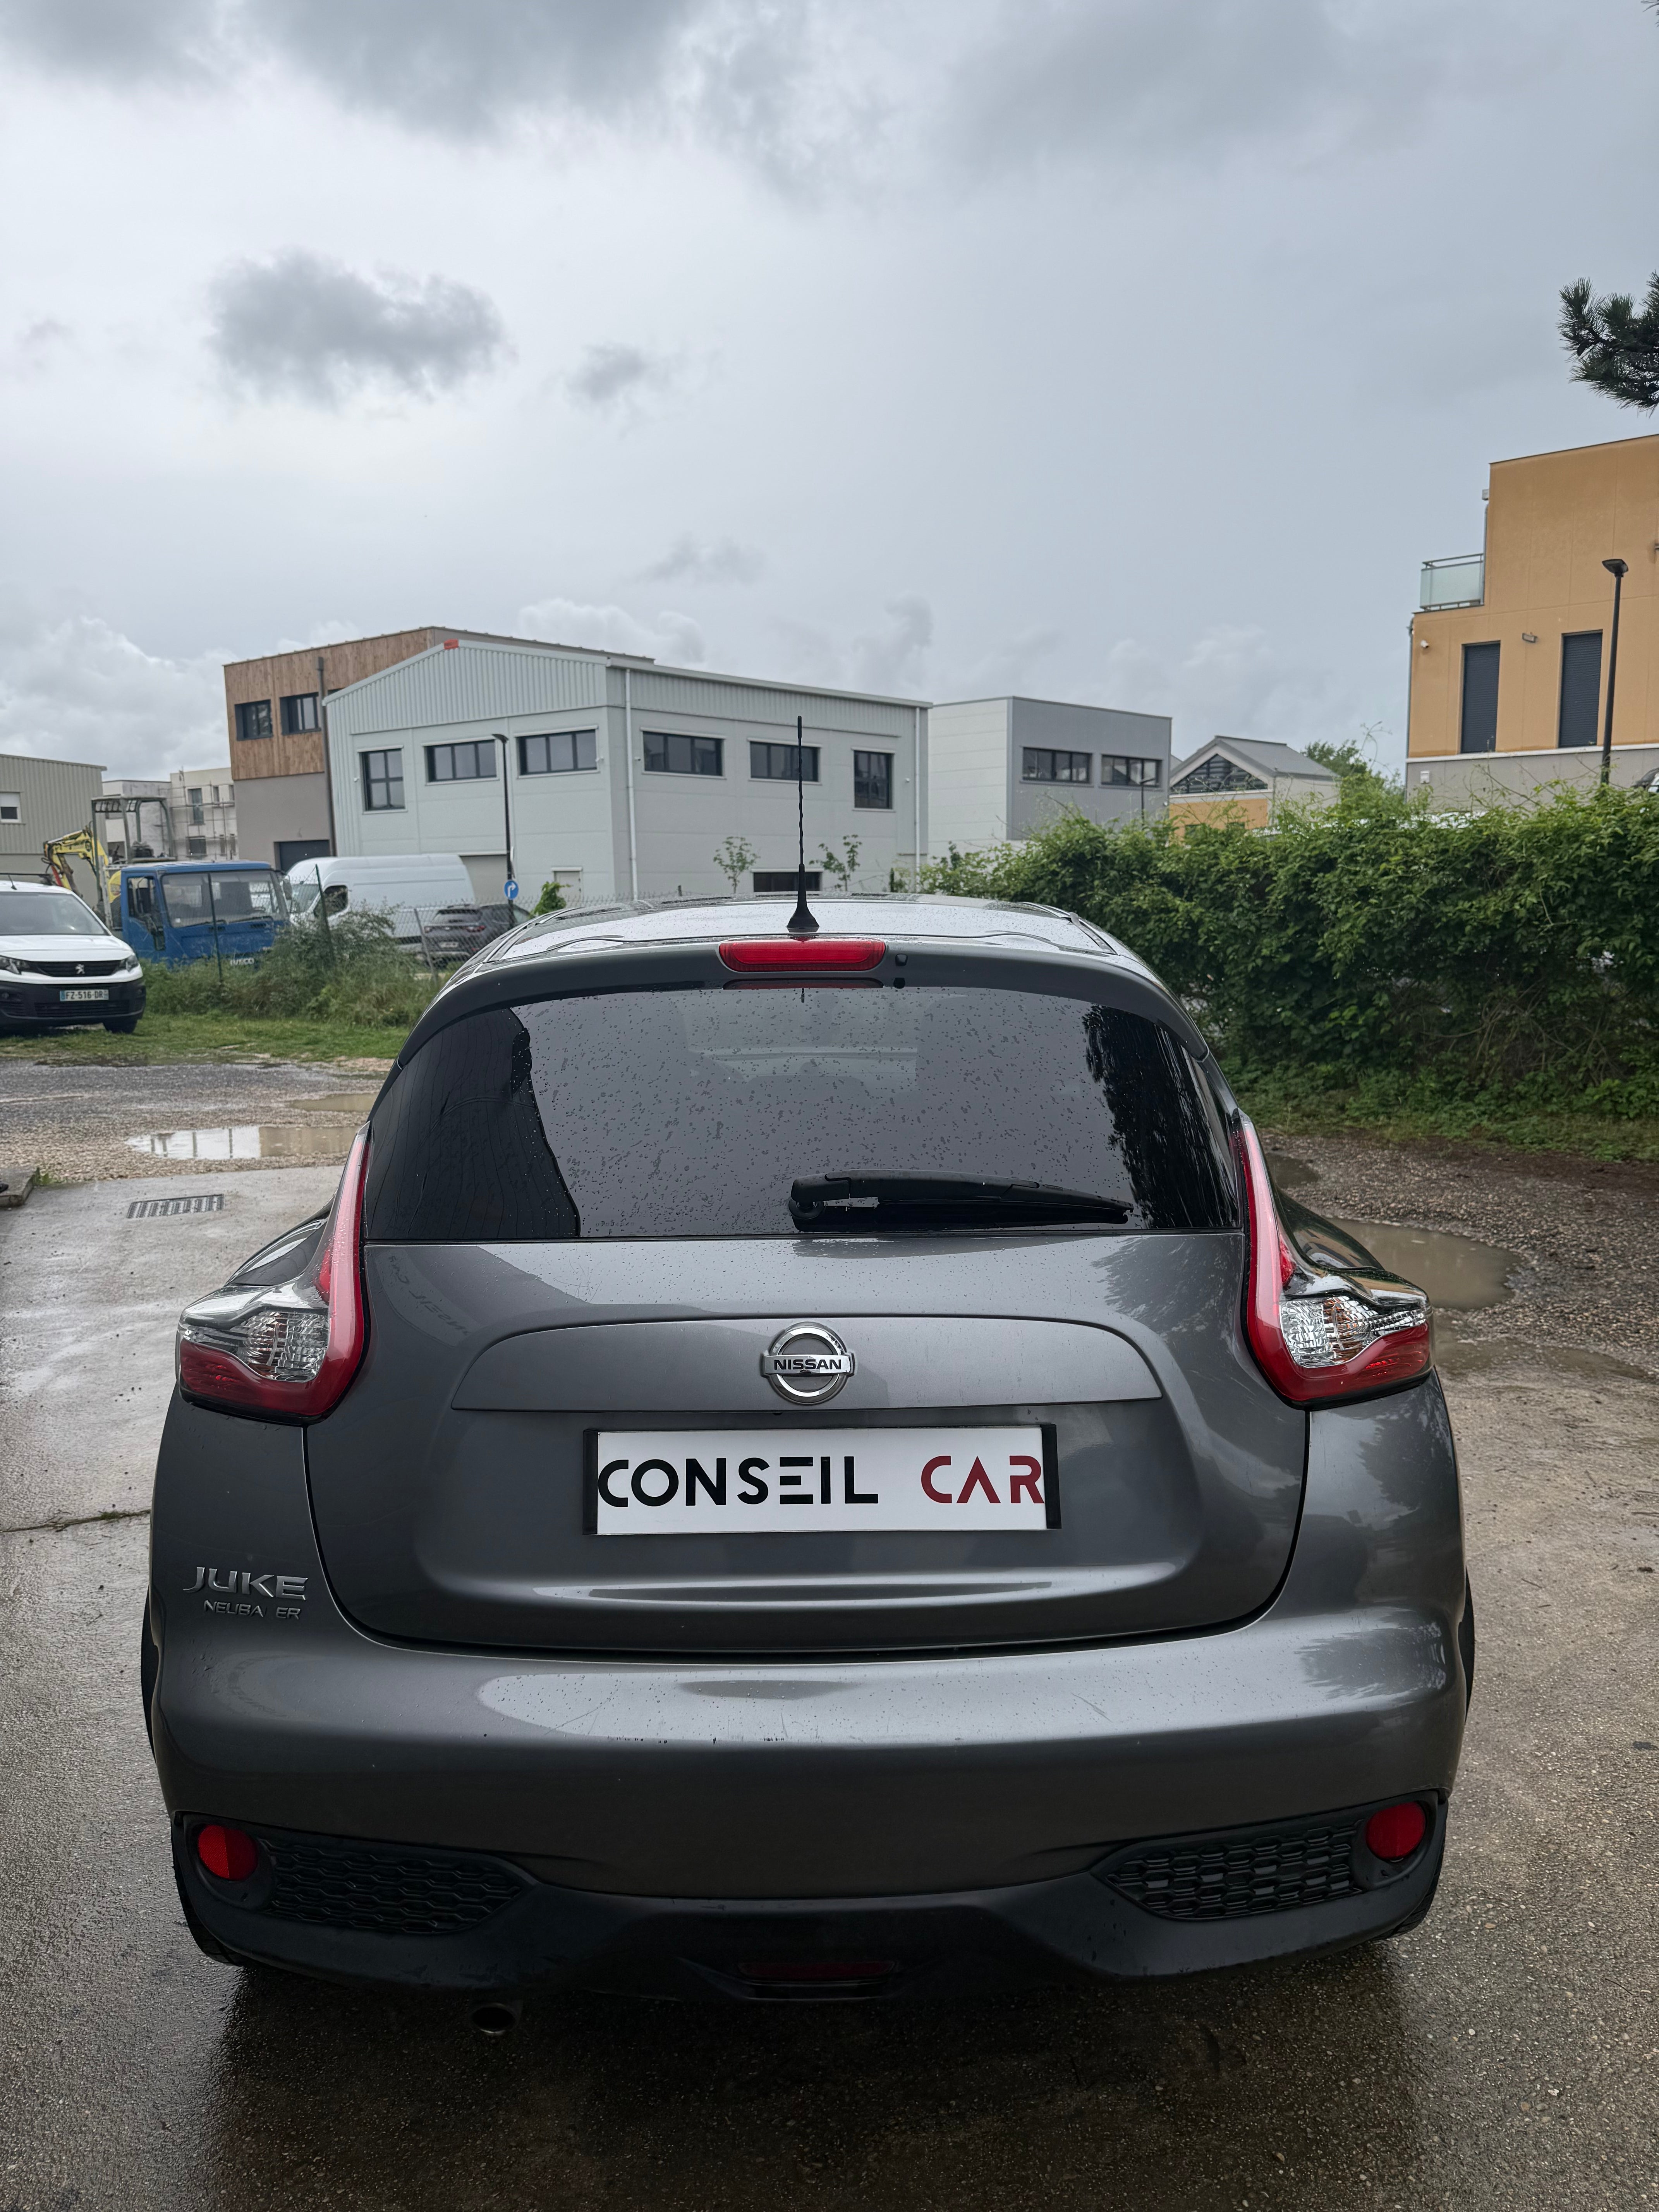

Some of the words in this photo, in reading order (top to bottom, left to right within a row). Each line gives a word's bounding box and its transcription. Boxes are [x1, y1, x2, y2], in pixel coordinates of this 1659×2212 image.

[65, 991, 103, 1000] FZ-516-DR
[774, 1359, 842, 1370] NISSAN
[598, 1456, 879, 1507] CONSEIL
[921, 1455, 1045, 1504] CAR
[183, 1566, 308, 1601] JUKE
